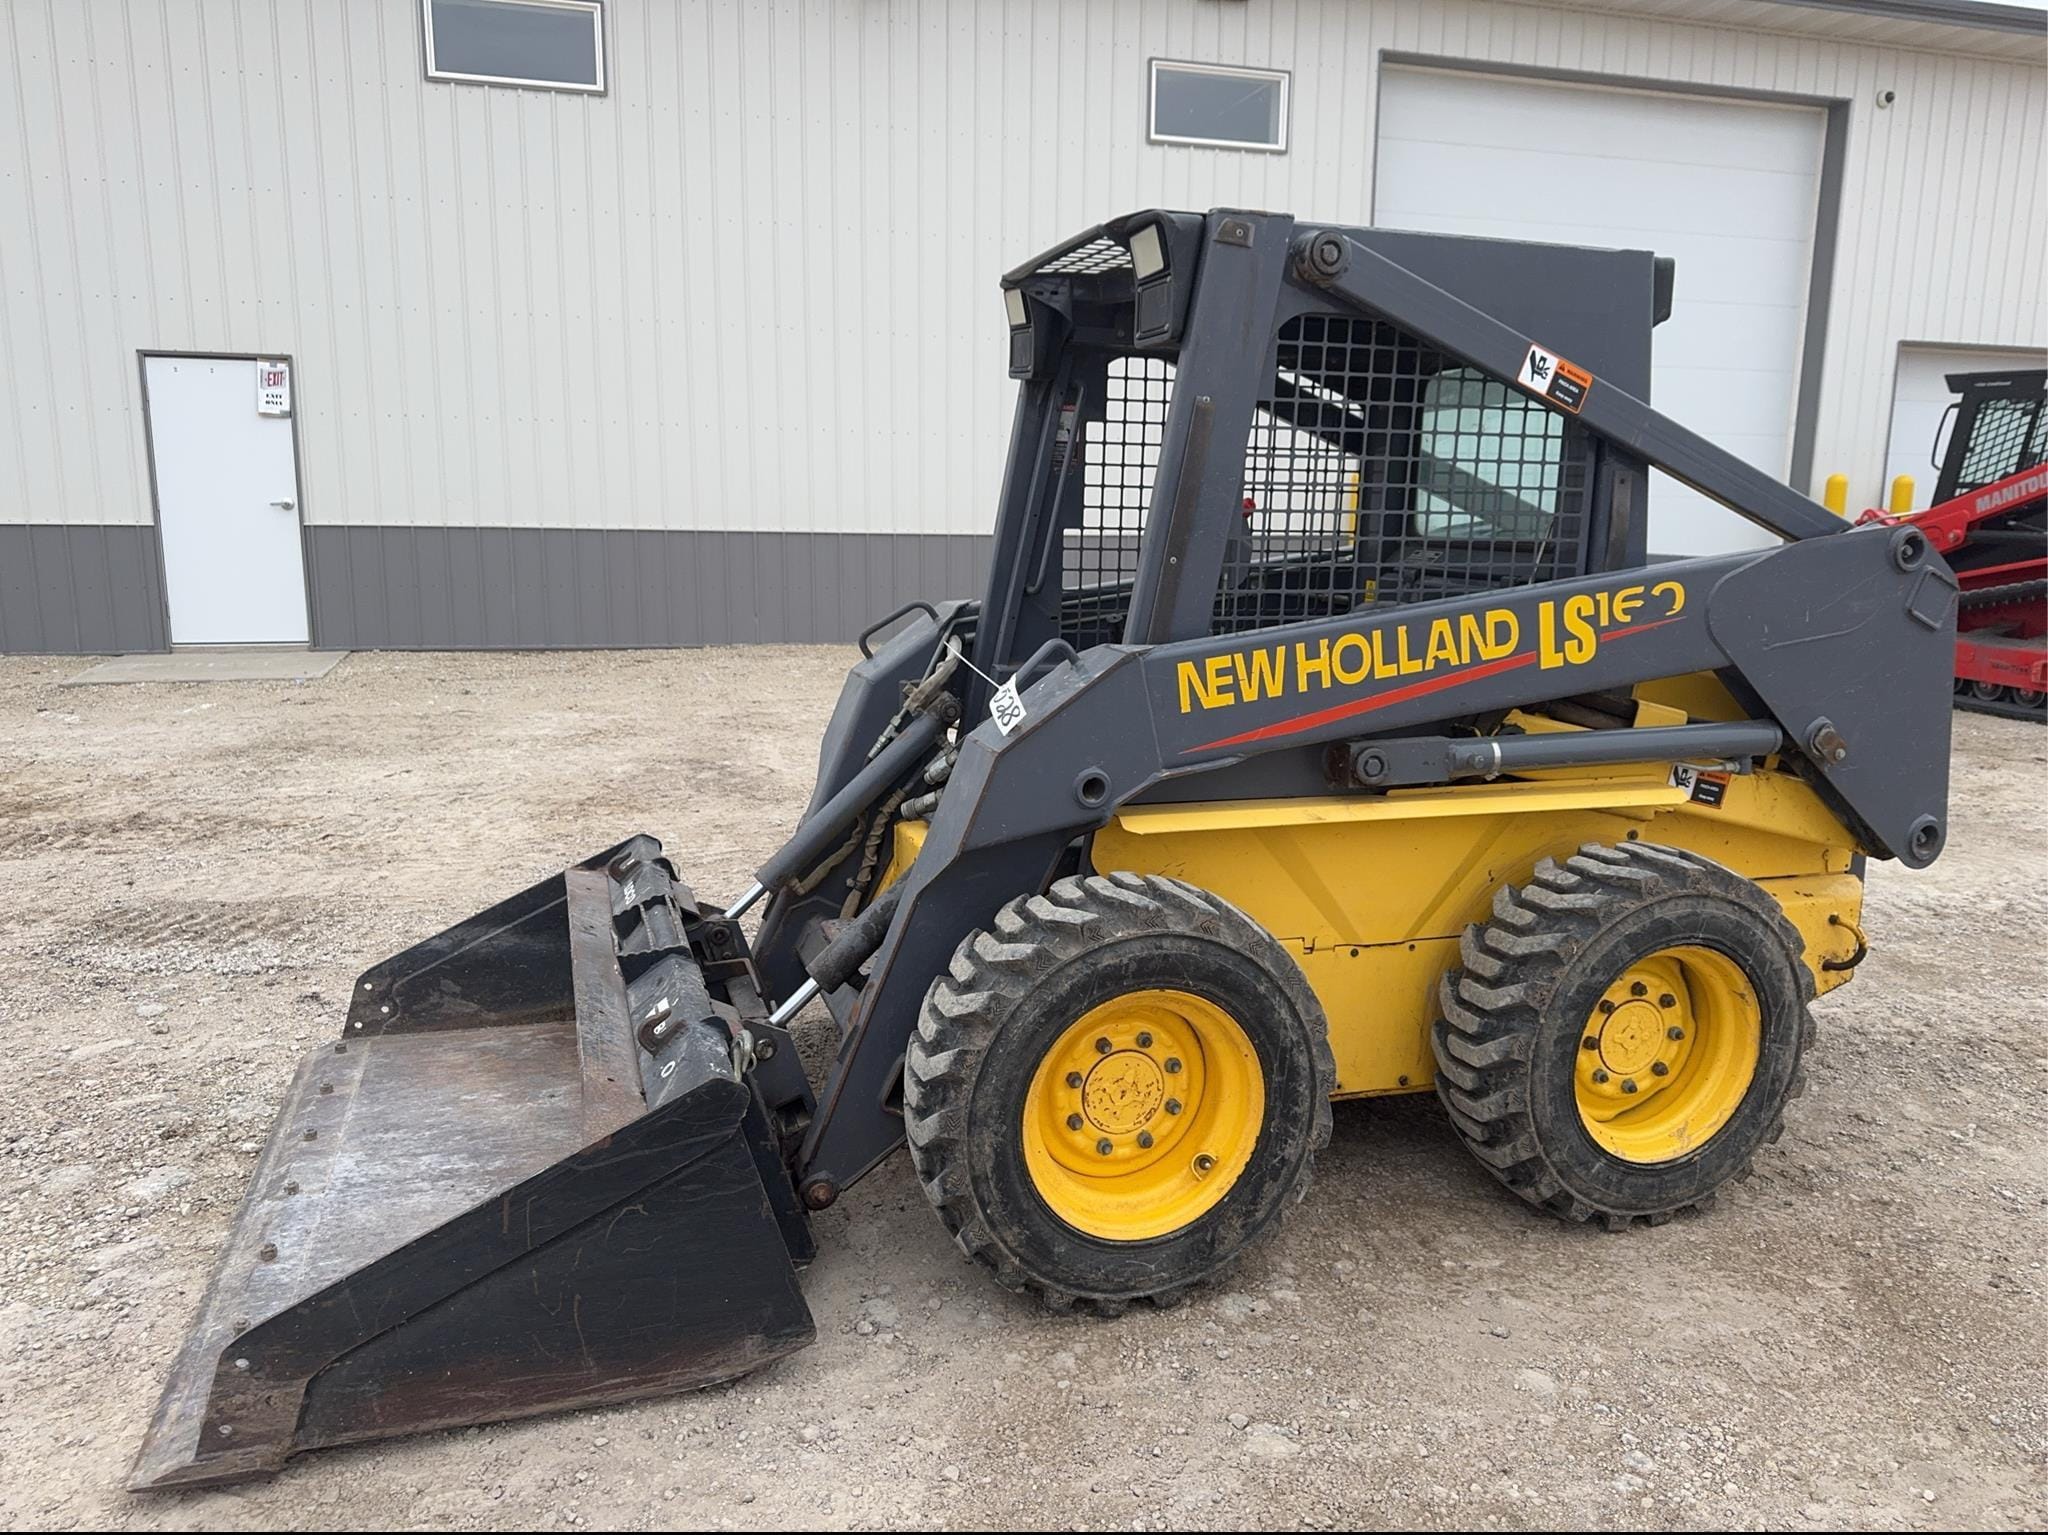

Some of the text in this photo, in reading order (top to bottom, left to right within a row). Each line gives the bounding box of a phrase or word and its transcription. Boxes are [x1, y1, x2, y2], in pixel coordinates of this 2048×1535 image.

[267, 371, 284, 387] EXIT
[1177, 645, 1286, 713] NEW
[1295, 609, 1519, 693] HOLLAND
[993, 687, 1020, 726] 528
